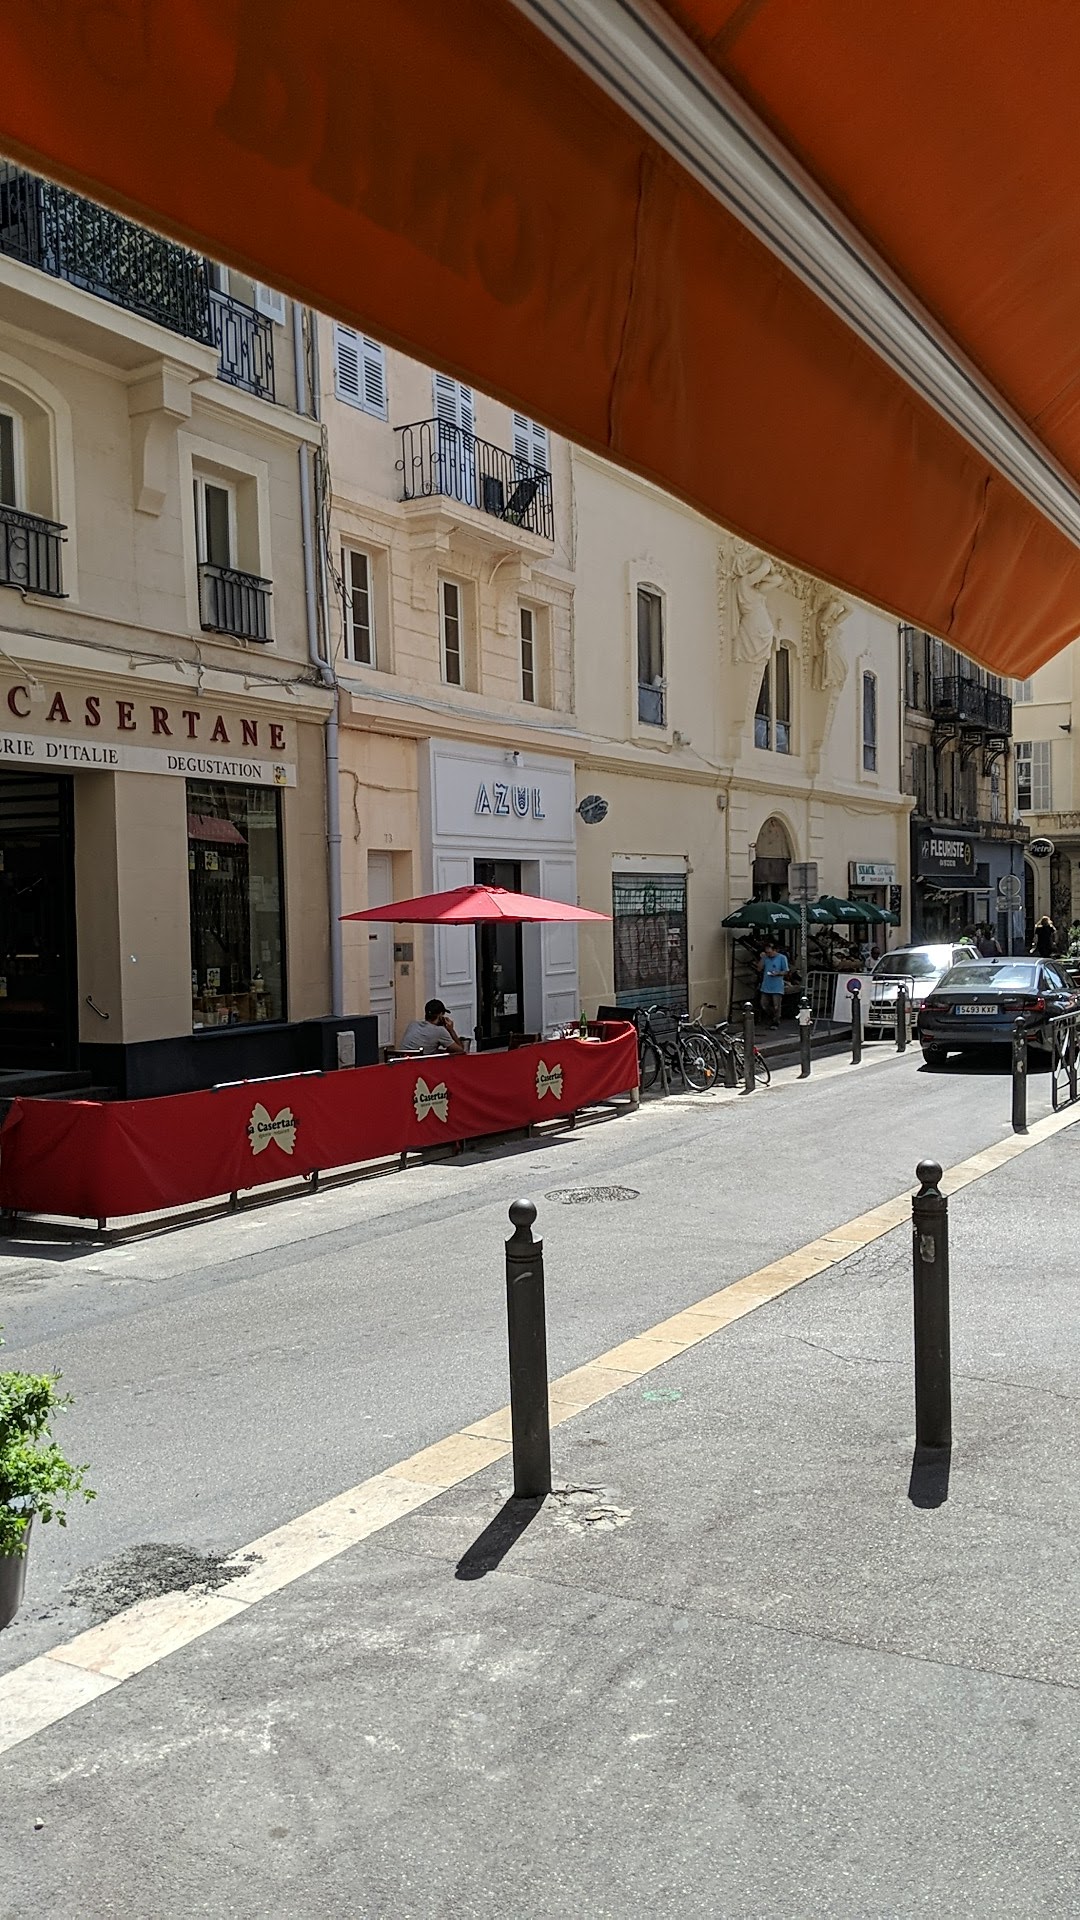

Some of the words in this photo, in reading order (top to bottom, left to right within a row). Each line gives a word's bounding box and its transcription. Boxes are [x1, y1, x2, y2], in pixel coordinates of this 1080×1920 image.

[7, 685, 287, 750] CASERTANE
[46, 742, 119, 765] D'ITALIE
[167, 755, 262, 779] DEGUSTATION
[475, 781, 546, 820] AZUL
[930, 839, 965, 858] FLEURISTE
[961, 1006, 980, 1014] 5493
